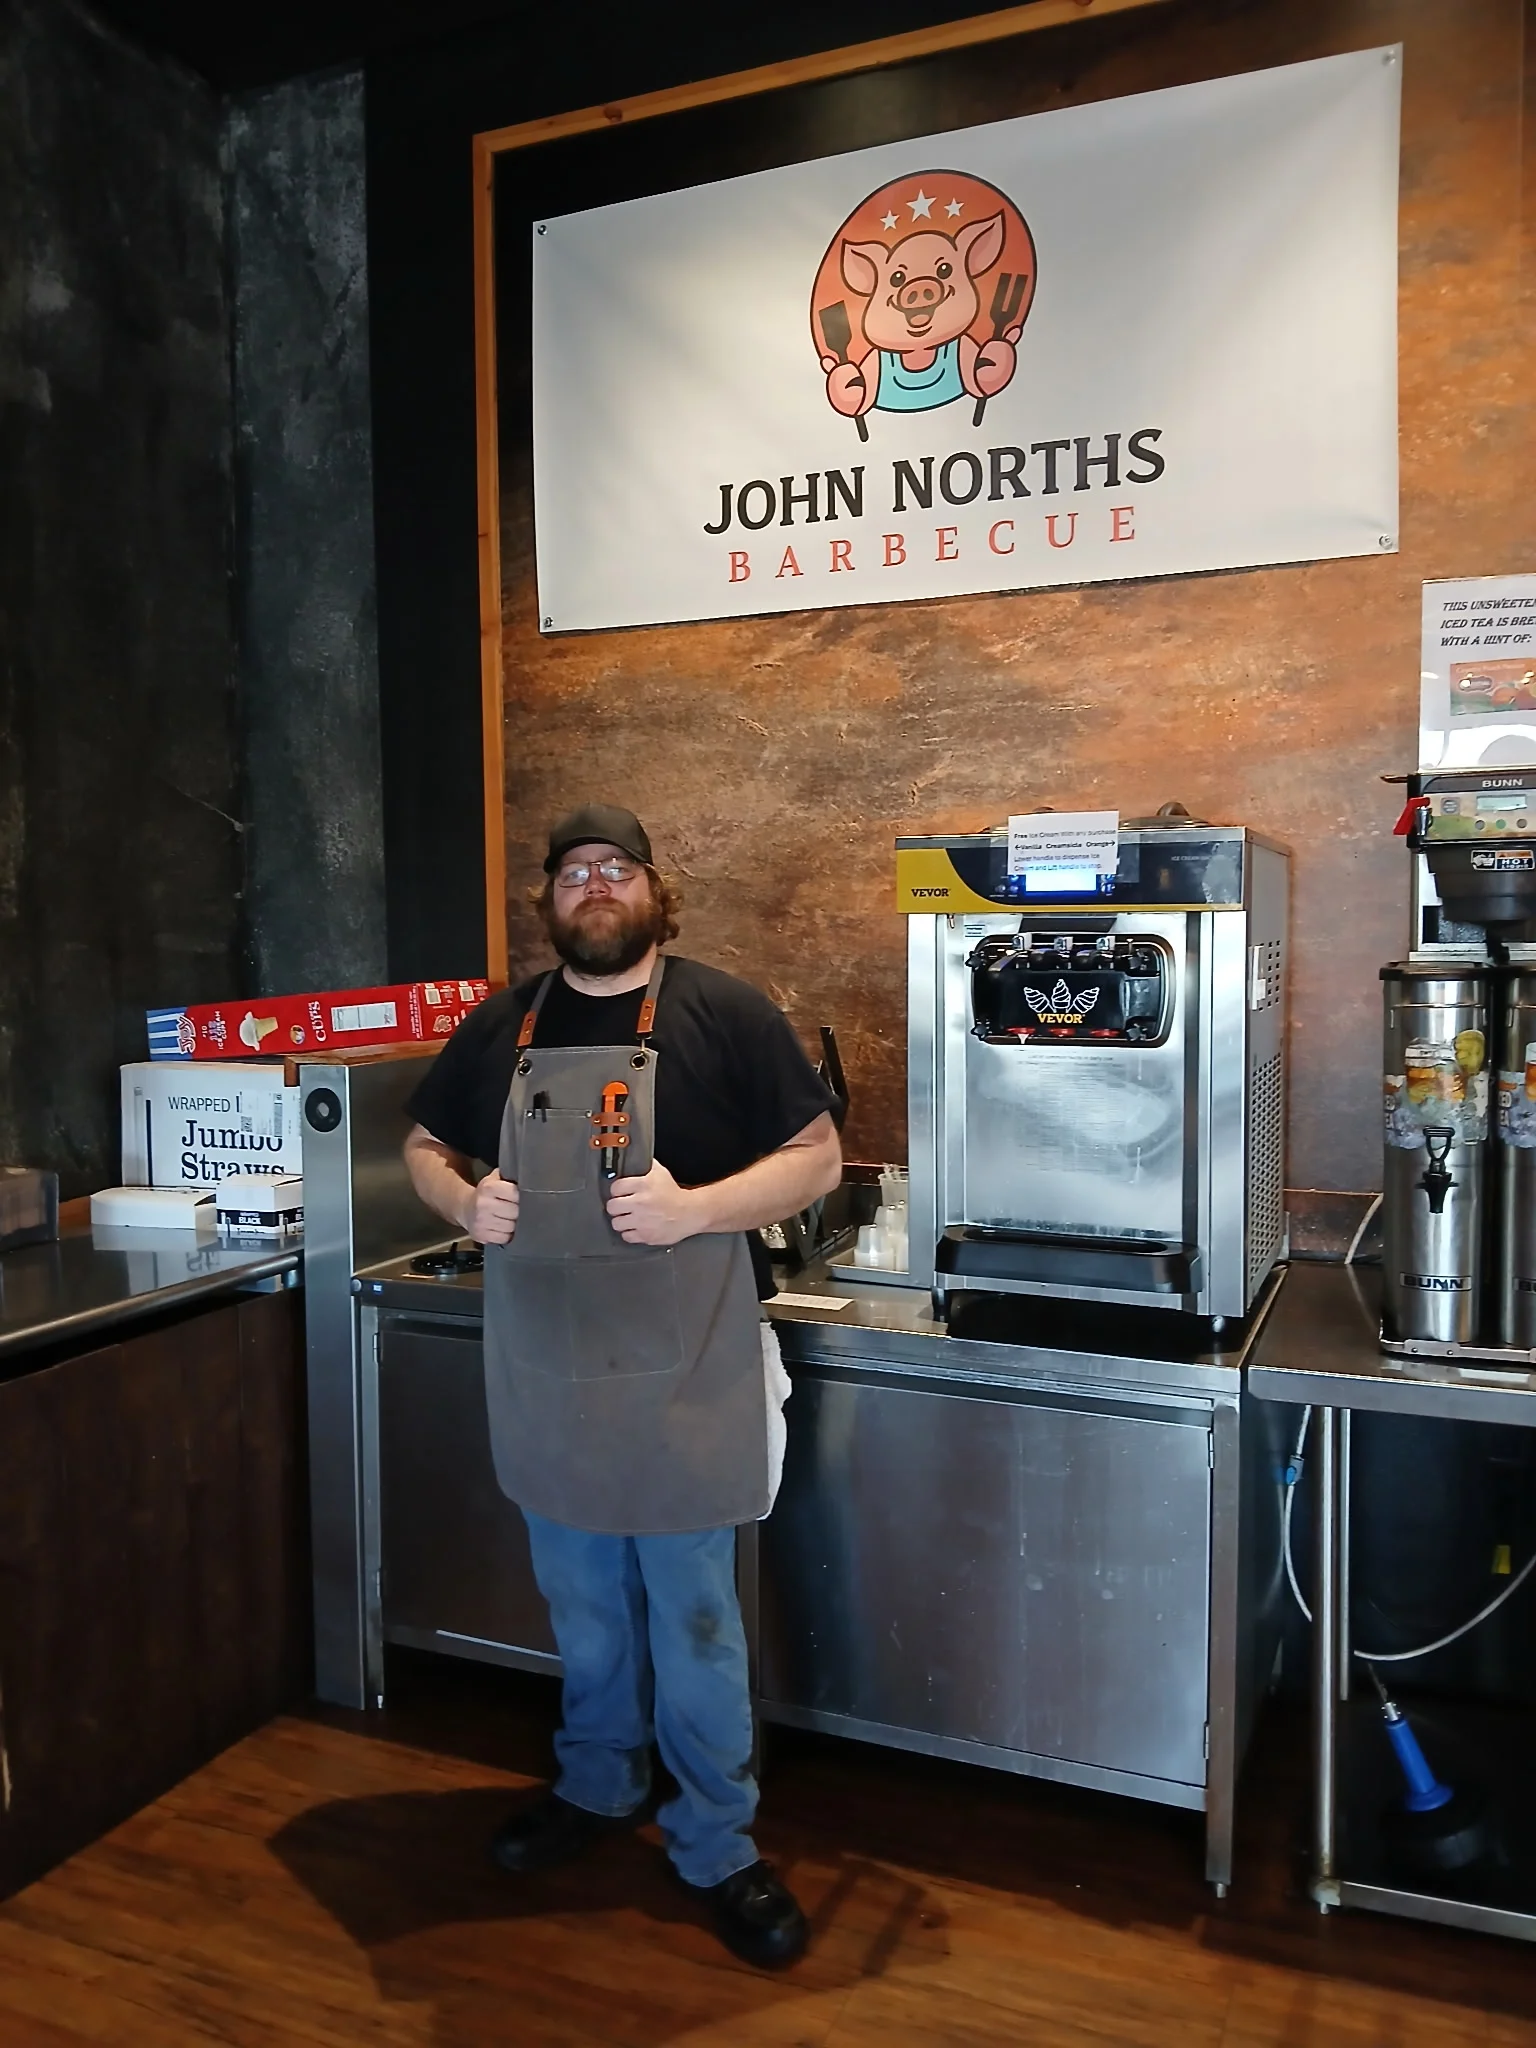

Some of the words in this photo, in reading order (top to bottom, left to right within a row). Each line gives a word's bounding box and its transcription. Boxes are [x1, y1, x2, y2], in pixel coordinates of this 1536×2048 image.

[703, 465, 866, 535] JOHN
[892, 428, 1166, 513] NORTHS
[727, 505, 1137, 583] BARBECUE
[1443, 602, 1468, 612] THIS
[1470, 598, 1536, 610] UNSWEETE
[1440, 619, 1468, 629] ICED
[1470, 618, 1493, 628] TEA
[1496, 617, 1510, 627] IS
[1510, 616, 1536, 626] BRE
[1441, 636, 1470, 647] WITH
[1471, 636, 1481, 646] A
[1483, 634, 1513, 645] HINT
[1513, 633, 1532, 643] OF:
[1482, 779, 1523, 788] BUNN
[911, 888, 950, 897] VEVOR
[310, 1001, 327, 1042] CUPS
[1037, 1013, 1084, 1024] VEVOR
[177, 1014, 196, 1054] JOY
[168, 1096, 231, 1113] WRAPPED
[238, 1216, 261, 1225] BLACK
[1404, 1274, 1464, 1290] BUNN
